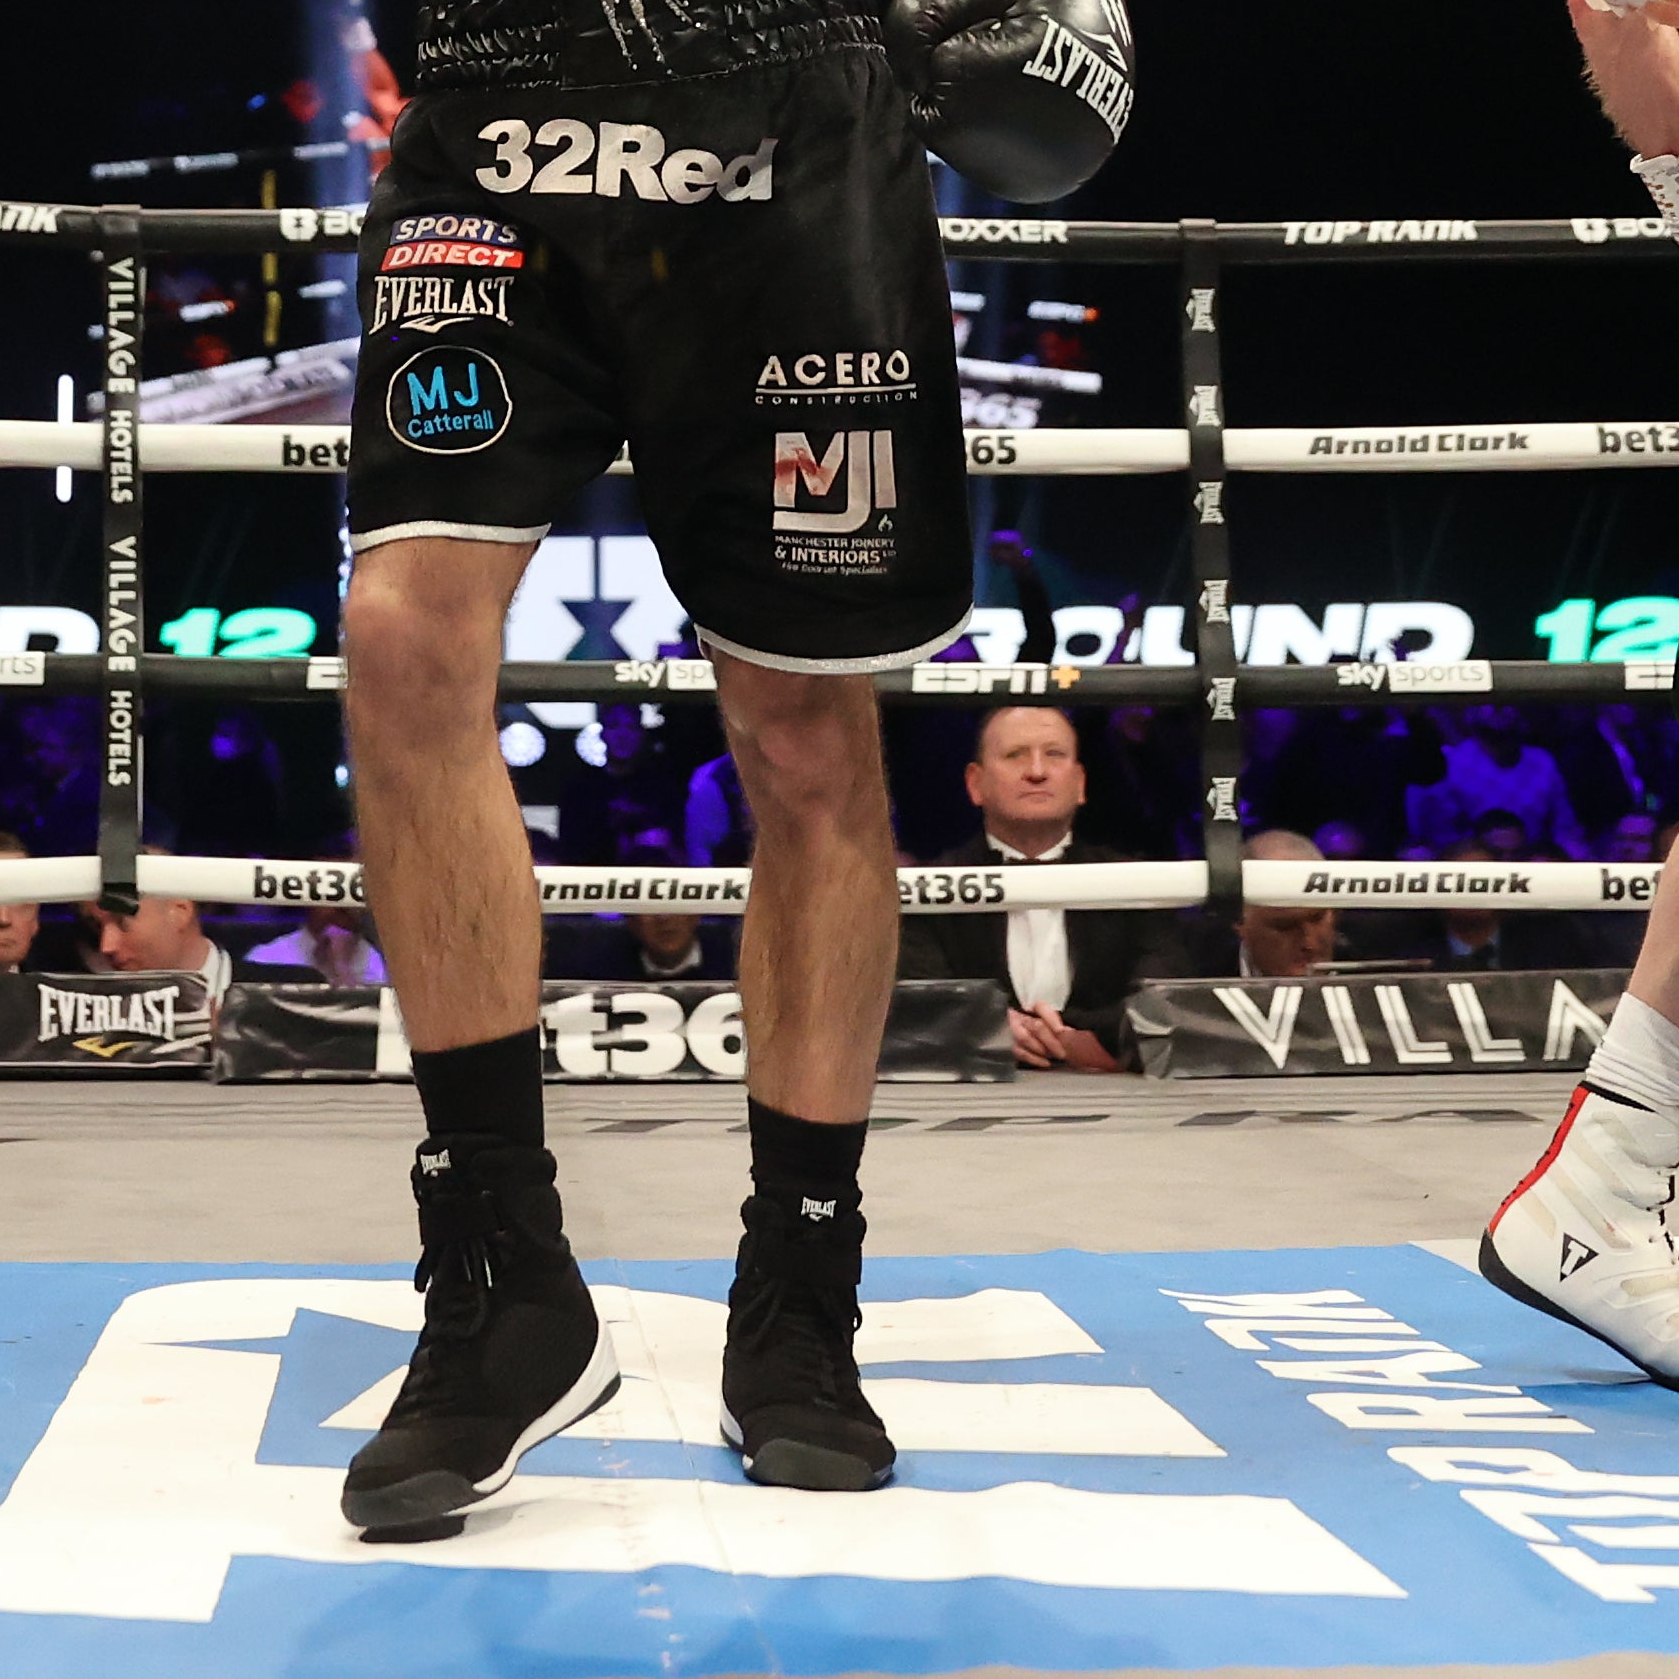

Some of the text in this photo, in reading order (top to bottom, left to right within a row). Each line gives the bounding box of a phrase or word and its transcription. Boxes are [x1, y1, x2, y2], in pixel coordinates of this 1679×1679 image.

[1022, 14, 1134, 145] EVERLAST
[475, 118, 778, 204] 32Red
[395, 215, 518, 244] SPORTS
[945, 218, 1068, 243] OXXER
[1282, 219, 1479, 245] TOP RANK
[388, 243, 515, 267] DIRECT
[368, 275, 515, 336] EVERLAST
[107, 256, 136, 504] VILLAGE HOTELS
[757, 349, 910, 386] ACERO
[406, 362, 479, 416] MJ
[407, 409, 494, 438] Catterall
[1308, 432, 1530, 455] Arnold Clark
[774, 535, 848, 548] MANCHESTER
[774, 545, 787, 559] &
[791, 547, 881, 564] INTERIORS
[160, 606, 317, 657] 12
[108, 536, 138, 787] VILLAGE HOTELS
[615, 660, 667, 687] sky
[1336, 663, 1485, 691] sky sports
[254, 865, 366, 902] bet36
[541, 877, 746, 901] rnold Clark
[898, 872, 1006, 905] et365
[1303, 872, 1532, 895] Arnold Clark
[37, 982, 180, 1043] EVERLAST
